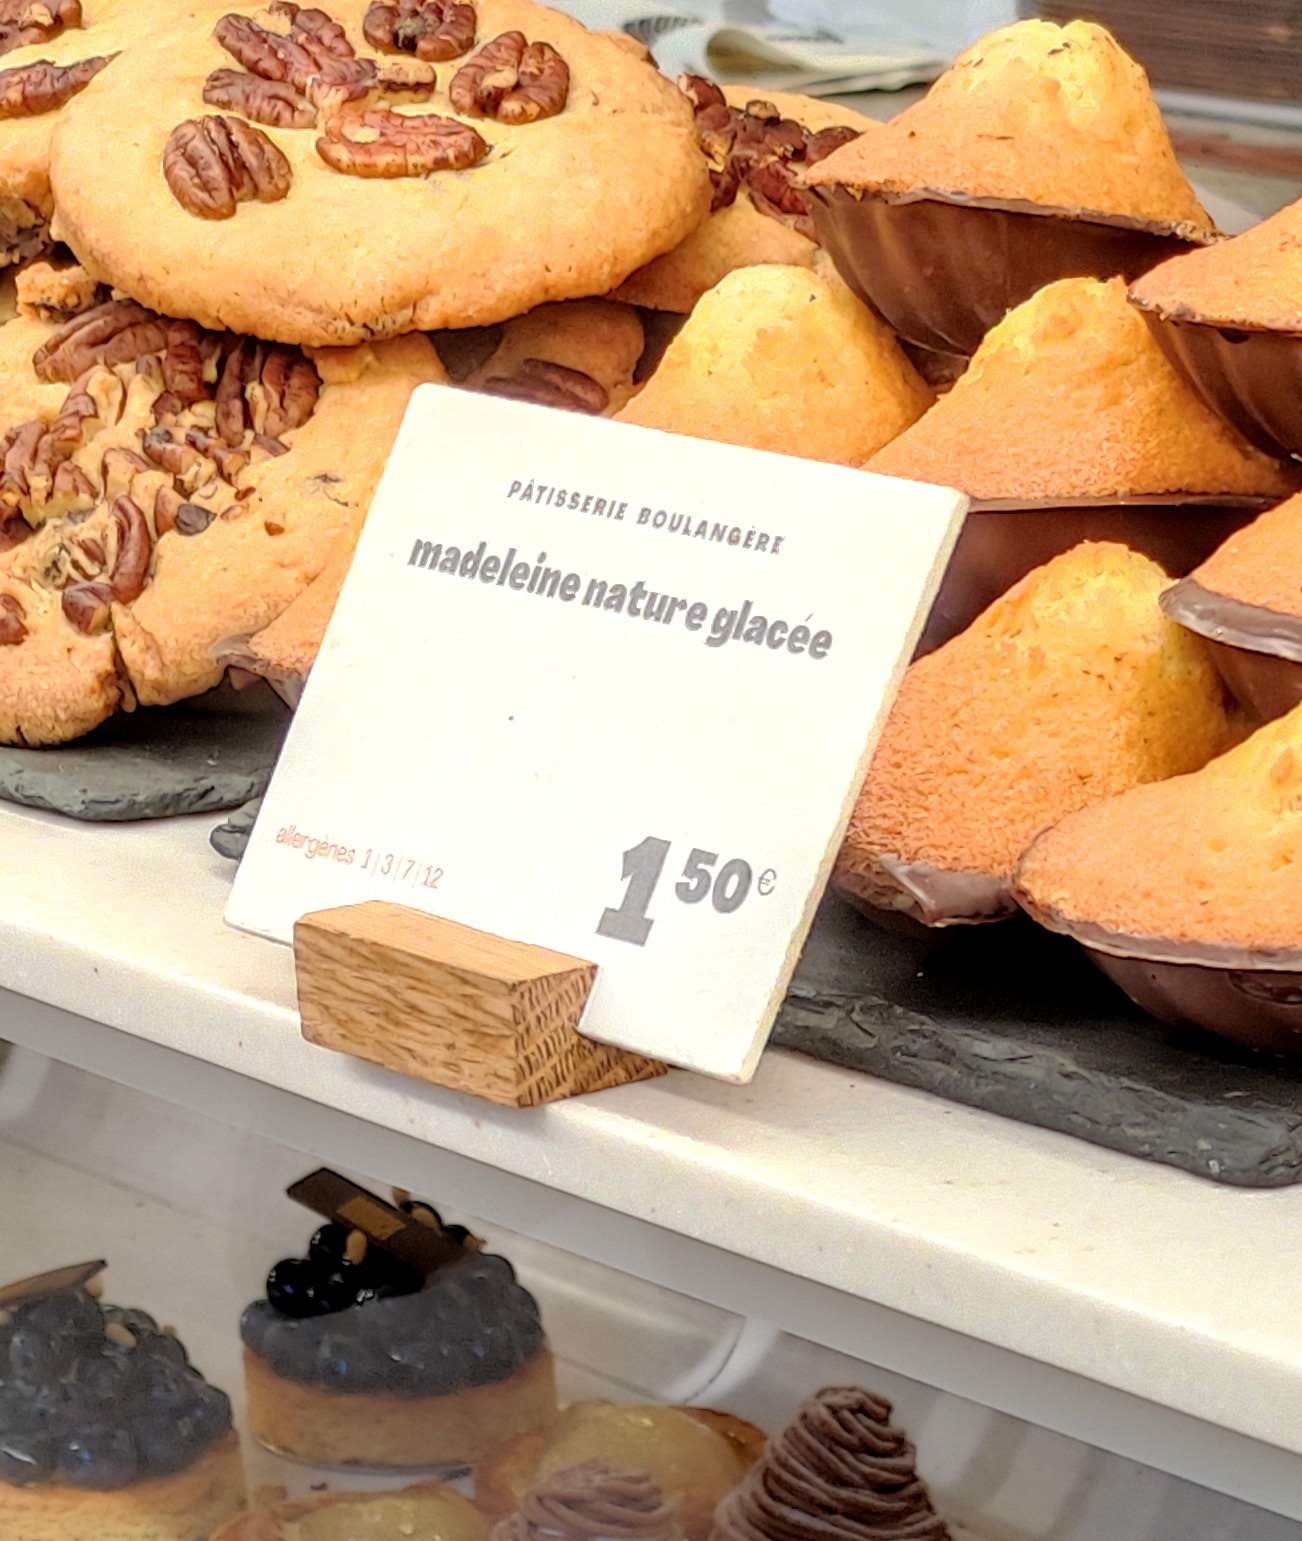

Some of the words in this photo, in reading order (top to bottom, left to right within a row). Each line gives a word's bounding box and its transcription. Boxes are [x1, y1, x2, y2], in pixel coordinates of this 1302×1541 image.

[407, 538, 581, 602] madeleine
[581, 580, 708, 631] nature
[704, 599, 833, 660] glacée
